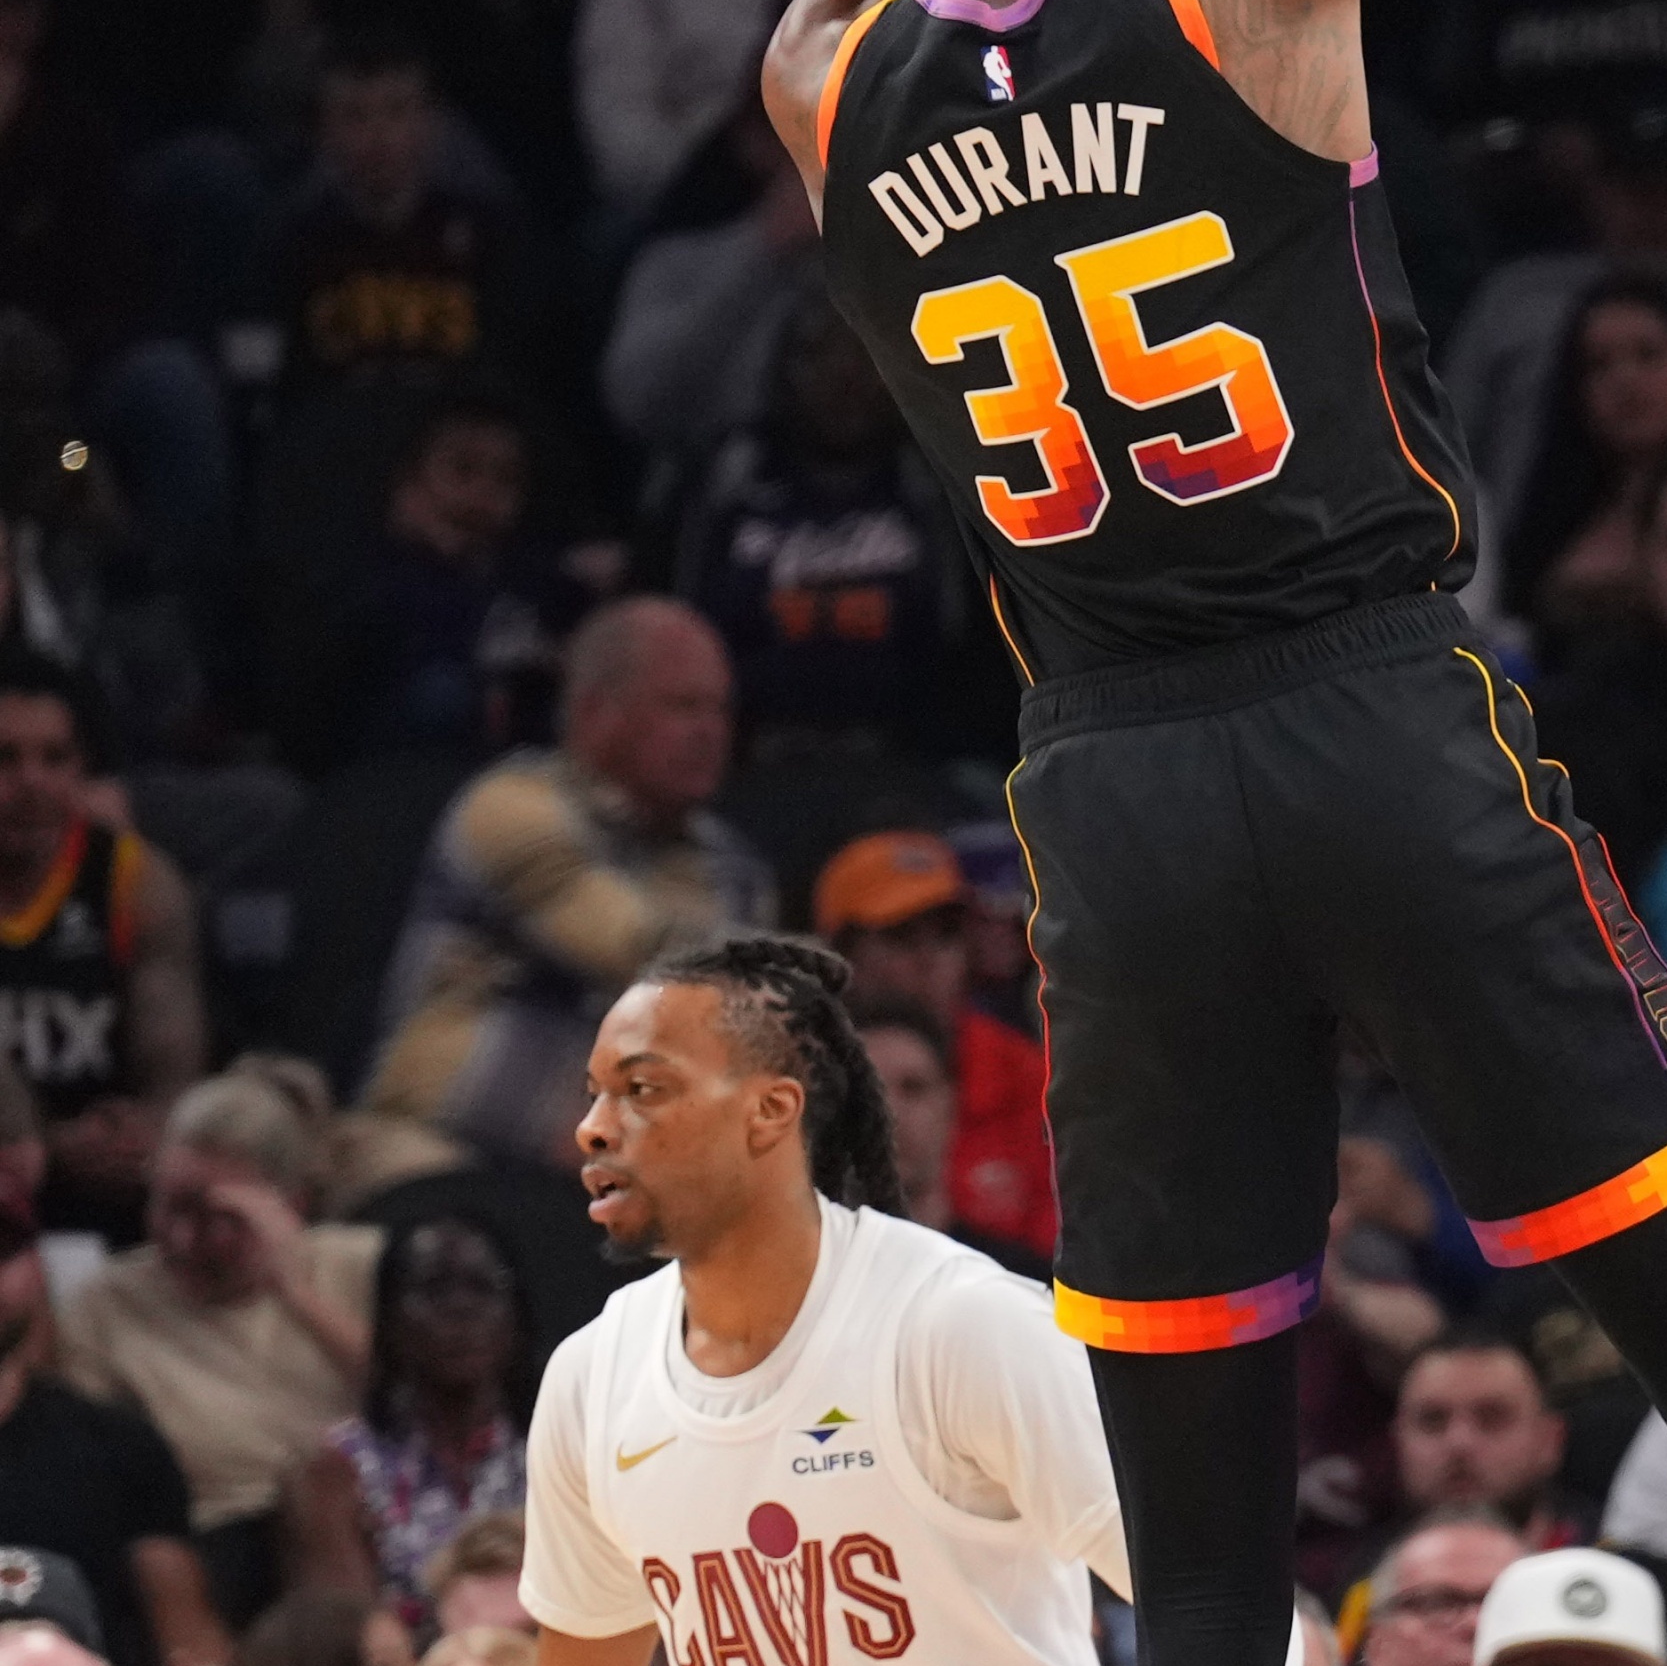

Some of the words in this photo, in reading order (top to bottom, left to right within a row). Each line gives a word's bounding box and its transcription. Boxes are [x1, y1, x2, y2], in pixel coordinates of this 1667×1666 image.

[868, 101, 1166, 258] DURANT
[910, 209, 1296, 547] 35
[792, 1448, 876, 1475] CLIFFS
